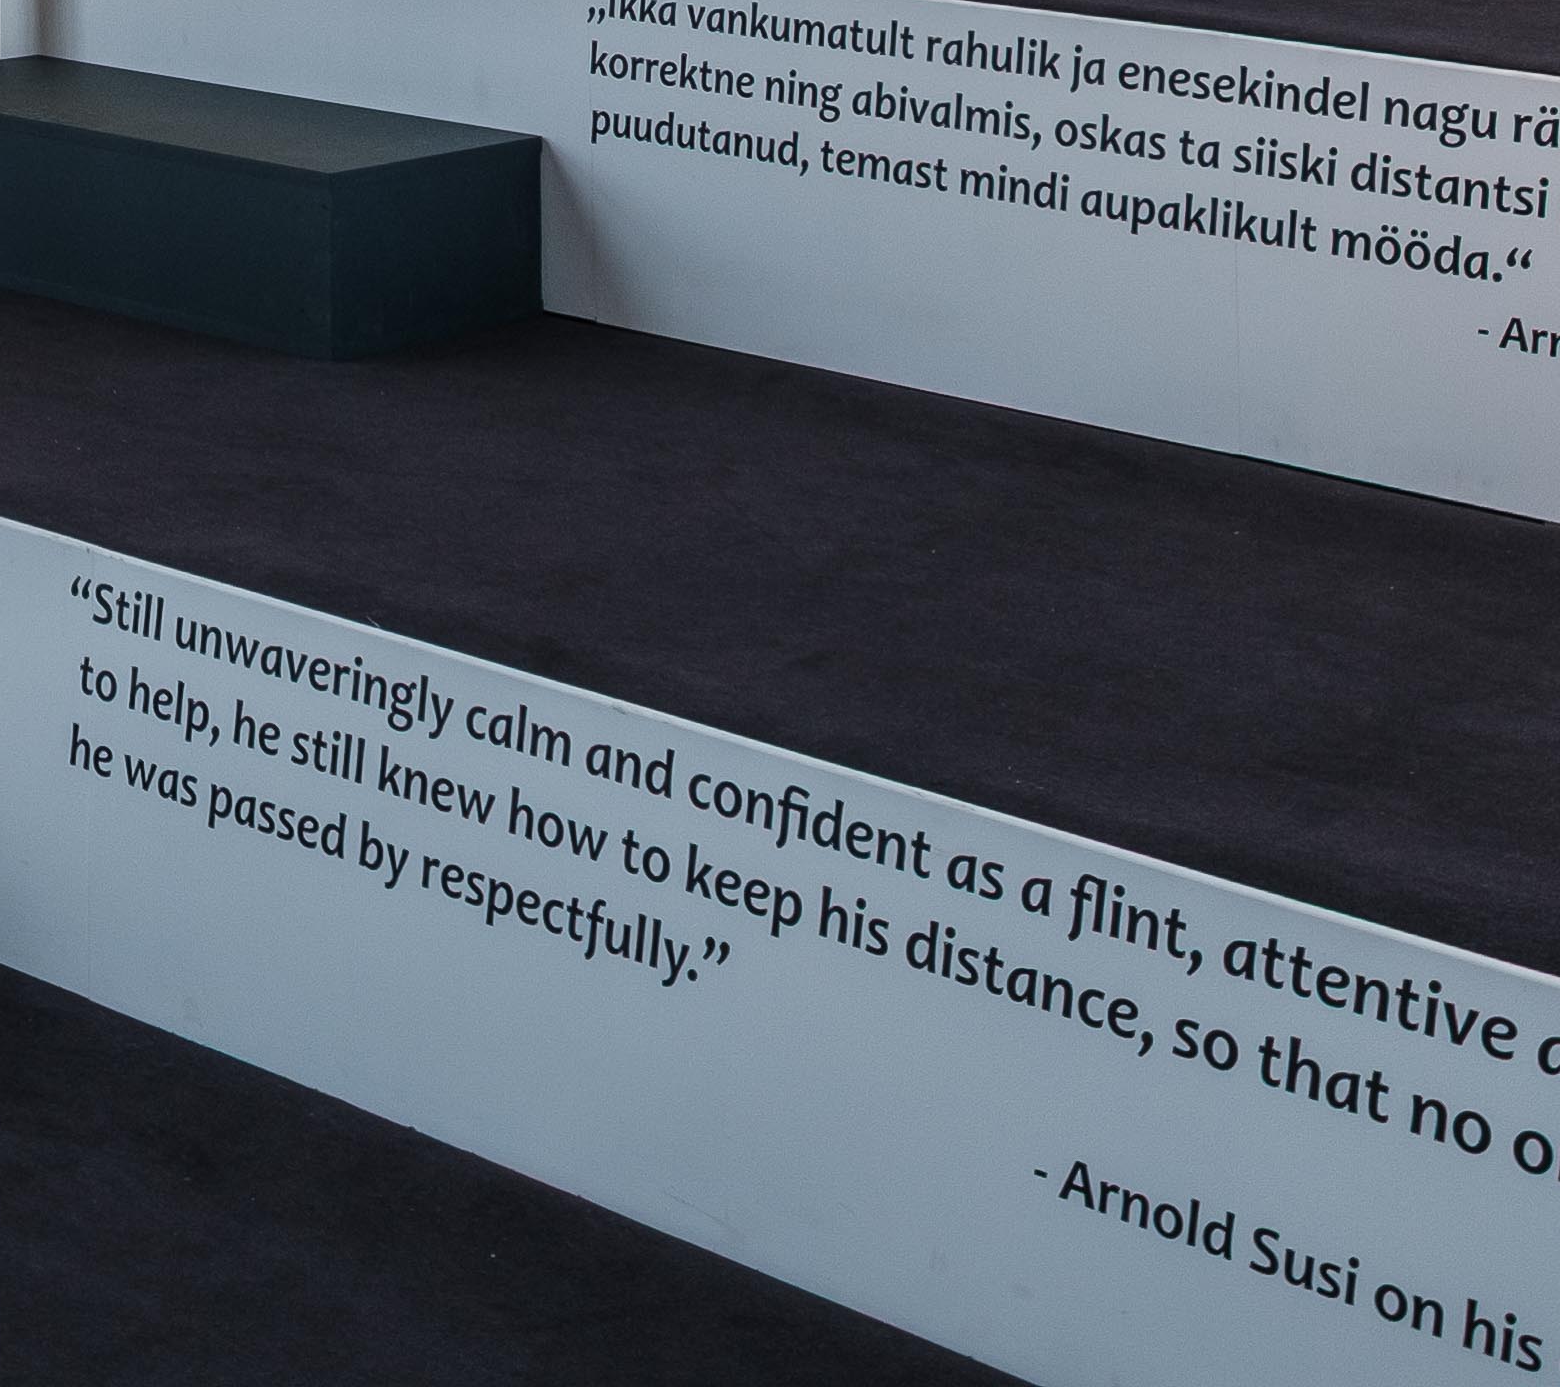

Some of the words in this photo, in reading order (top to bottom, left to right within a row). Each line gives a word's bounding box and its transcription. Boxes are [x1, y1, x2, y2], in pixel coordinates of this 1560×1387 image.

[591, 110, 808, 176] puudutanud,
[821, 141, 947, 191] temast
[960, 165, 1069, 211] mindi
[1081, 190, 1316, 252] aupaklikult
[70, 723, 113, 777] he
[124, 755, 197, 807] was
[208, 784, 347, 859] passed
[359, 820, 409, 889] by
[1059, 1161, 1235, 1260] Arnold
[1249, 1228, 1359, 1305] Susi
[1375, 1284, 1443, 1338] on
[1463, 1299, 1542, 1372] his
